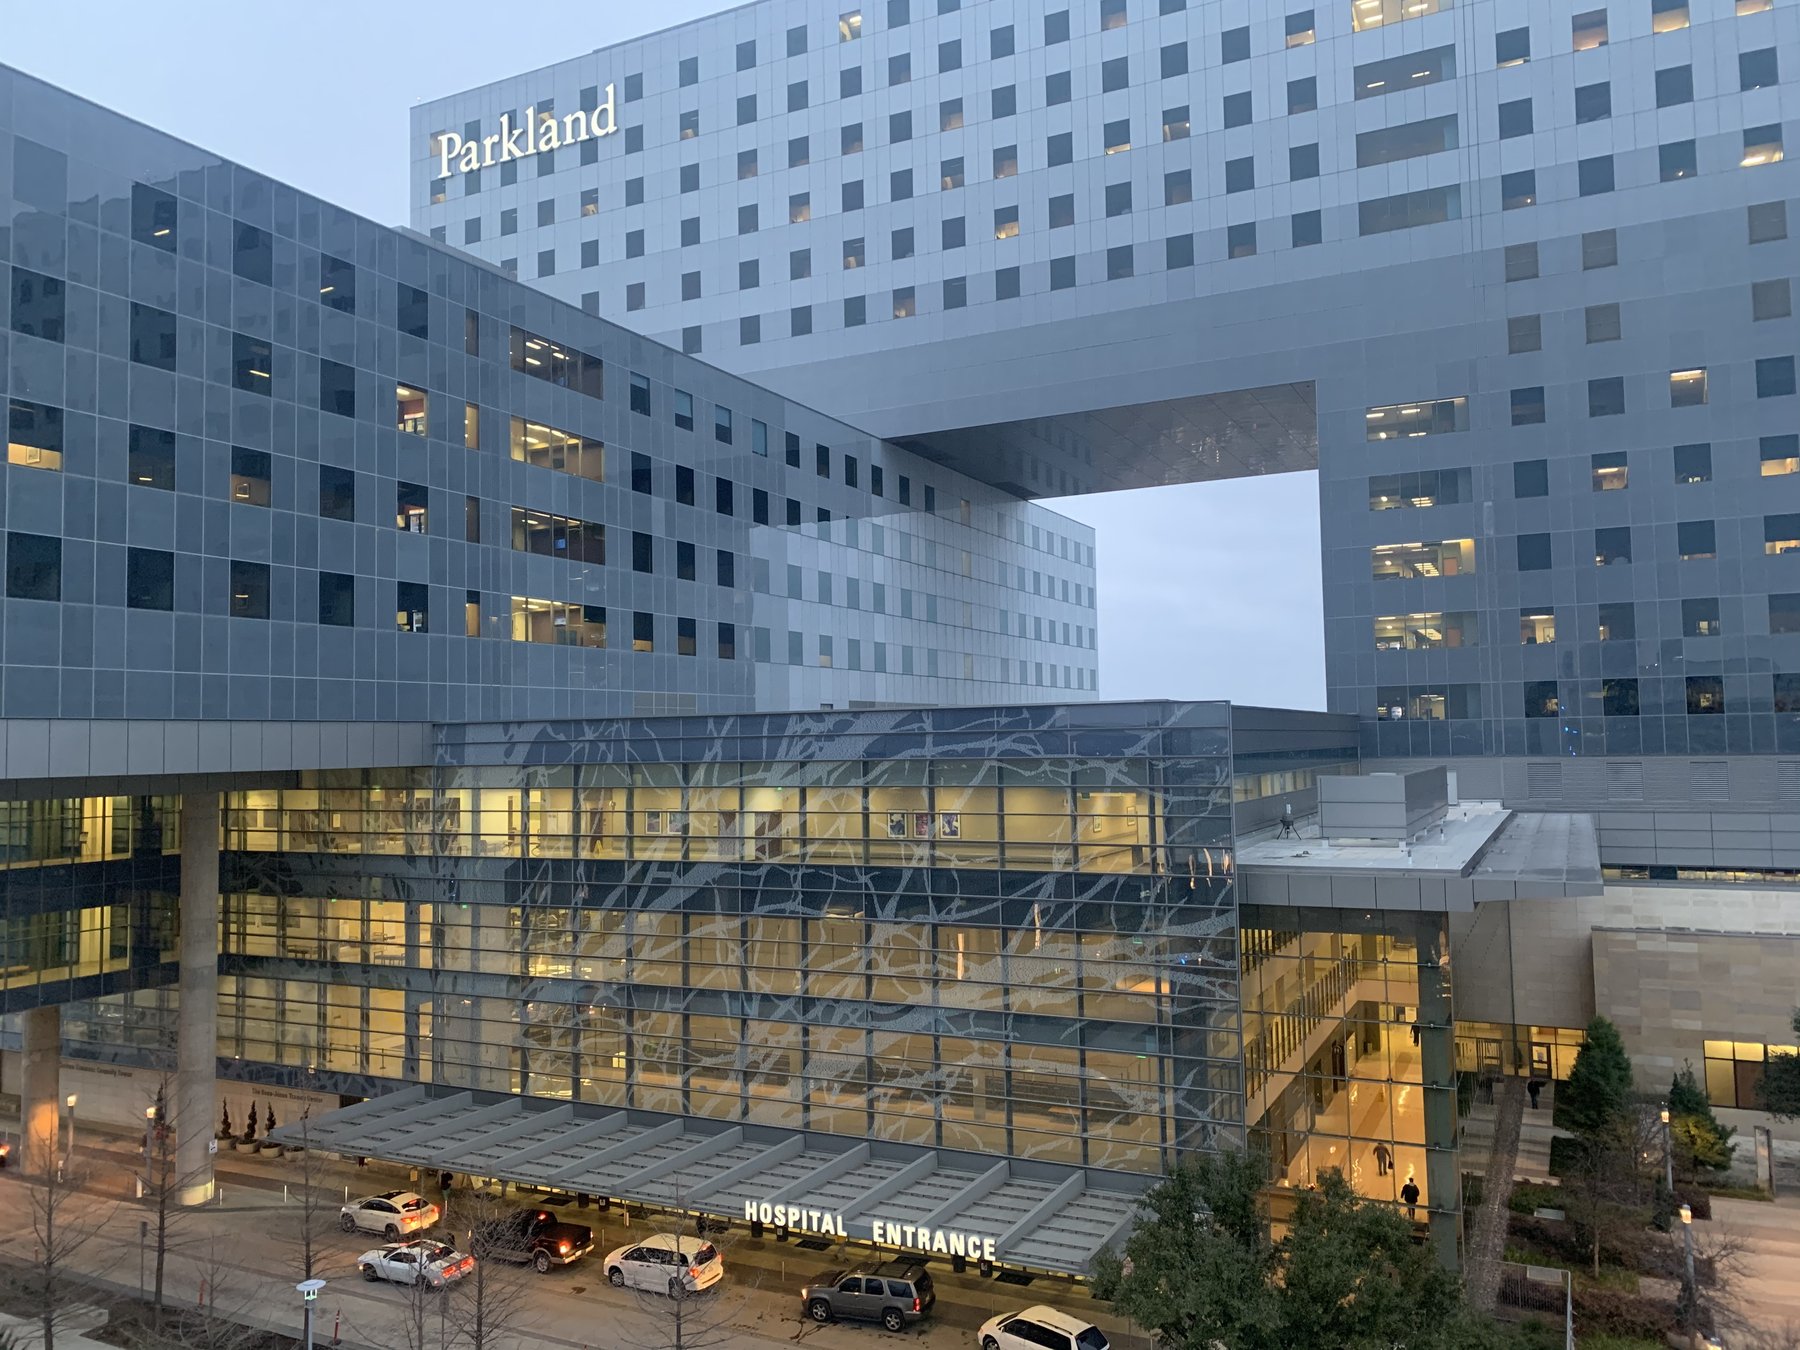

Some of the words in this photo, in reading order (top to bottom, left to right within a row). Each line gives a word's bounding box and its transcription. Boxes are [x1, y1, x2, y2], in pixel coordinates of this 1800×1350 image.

[438, 83, 618, 179] Parkland
[744, 1200, 848, 1237] HOSPITAL
[872, 1219, 997, 1262] ENTRANCE
